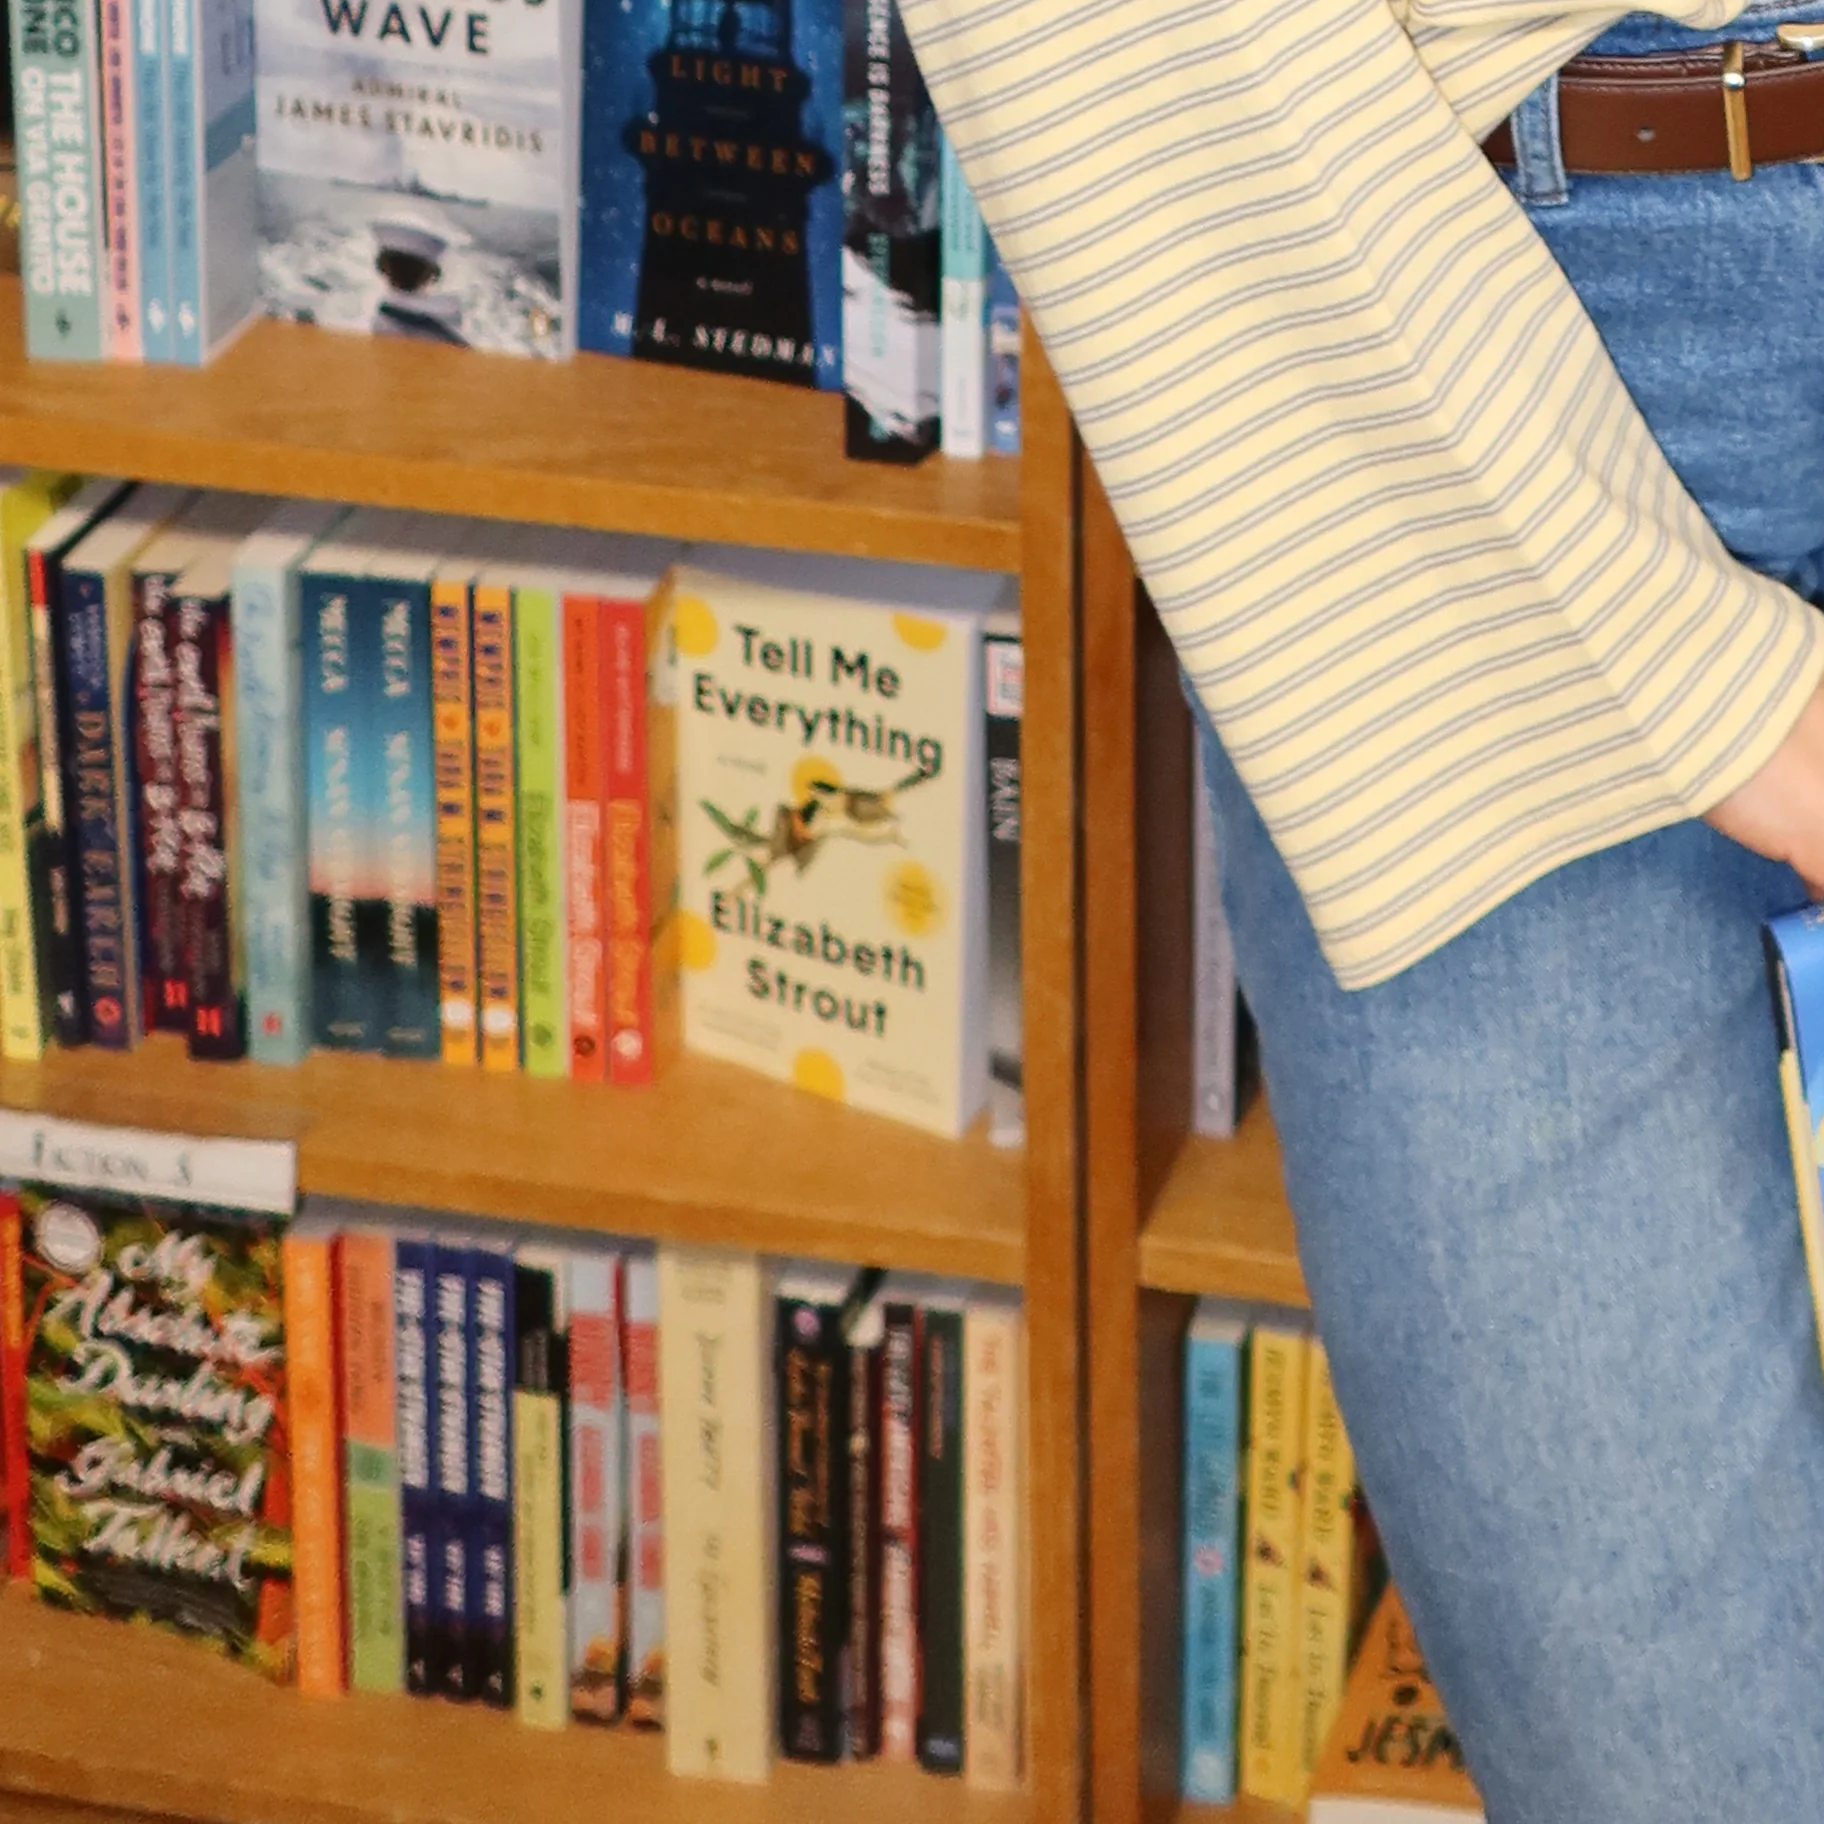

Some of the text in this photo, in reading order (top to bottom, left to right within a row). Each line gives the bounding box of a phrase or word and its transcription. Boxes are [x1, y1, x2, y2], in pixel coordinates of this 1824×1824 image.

[671, 54, 789, 95] LIGHT
[275, 95, 545, 154] JAMES STAVRIDIS
[638, 129, 816, 176] BETWEEN
[652, 211, 800, 255] OCEANS
[733, 624, 902, 698] Tell Me
[692, 675, 943, 777] Everything
[709, 891, 927, 992] Elizabeth
[744, 958, 890, 1038] Strout
